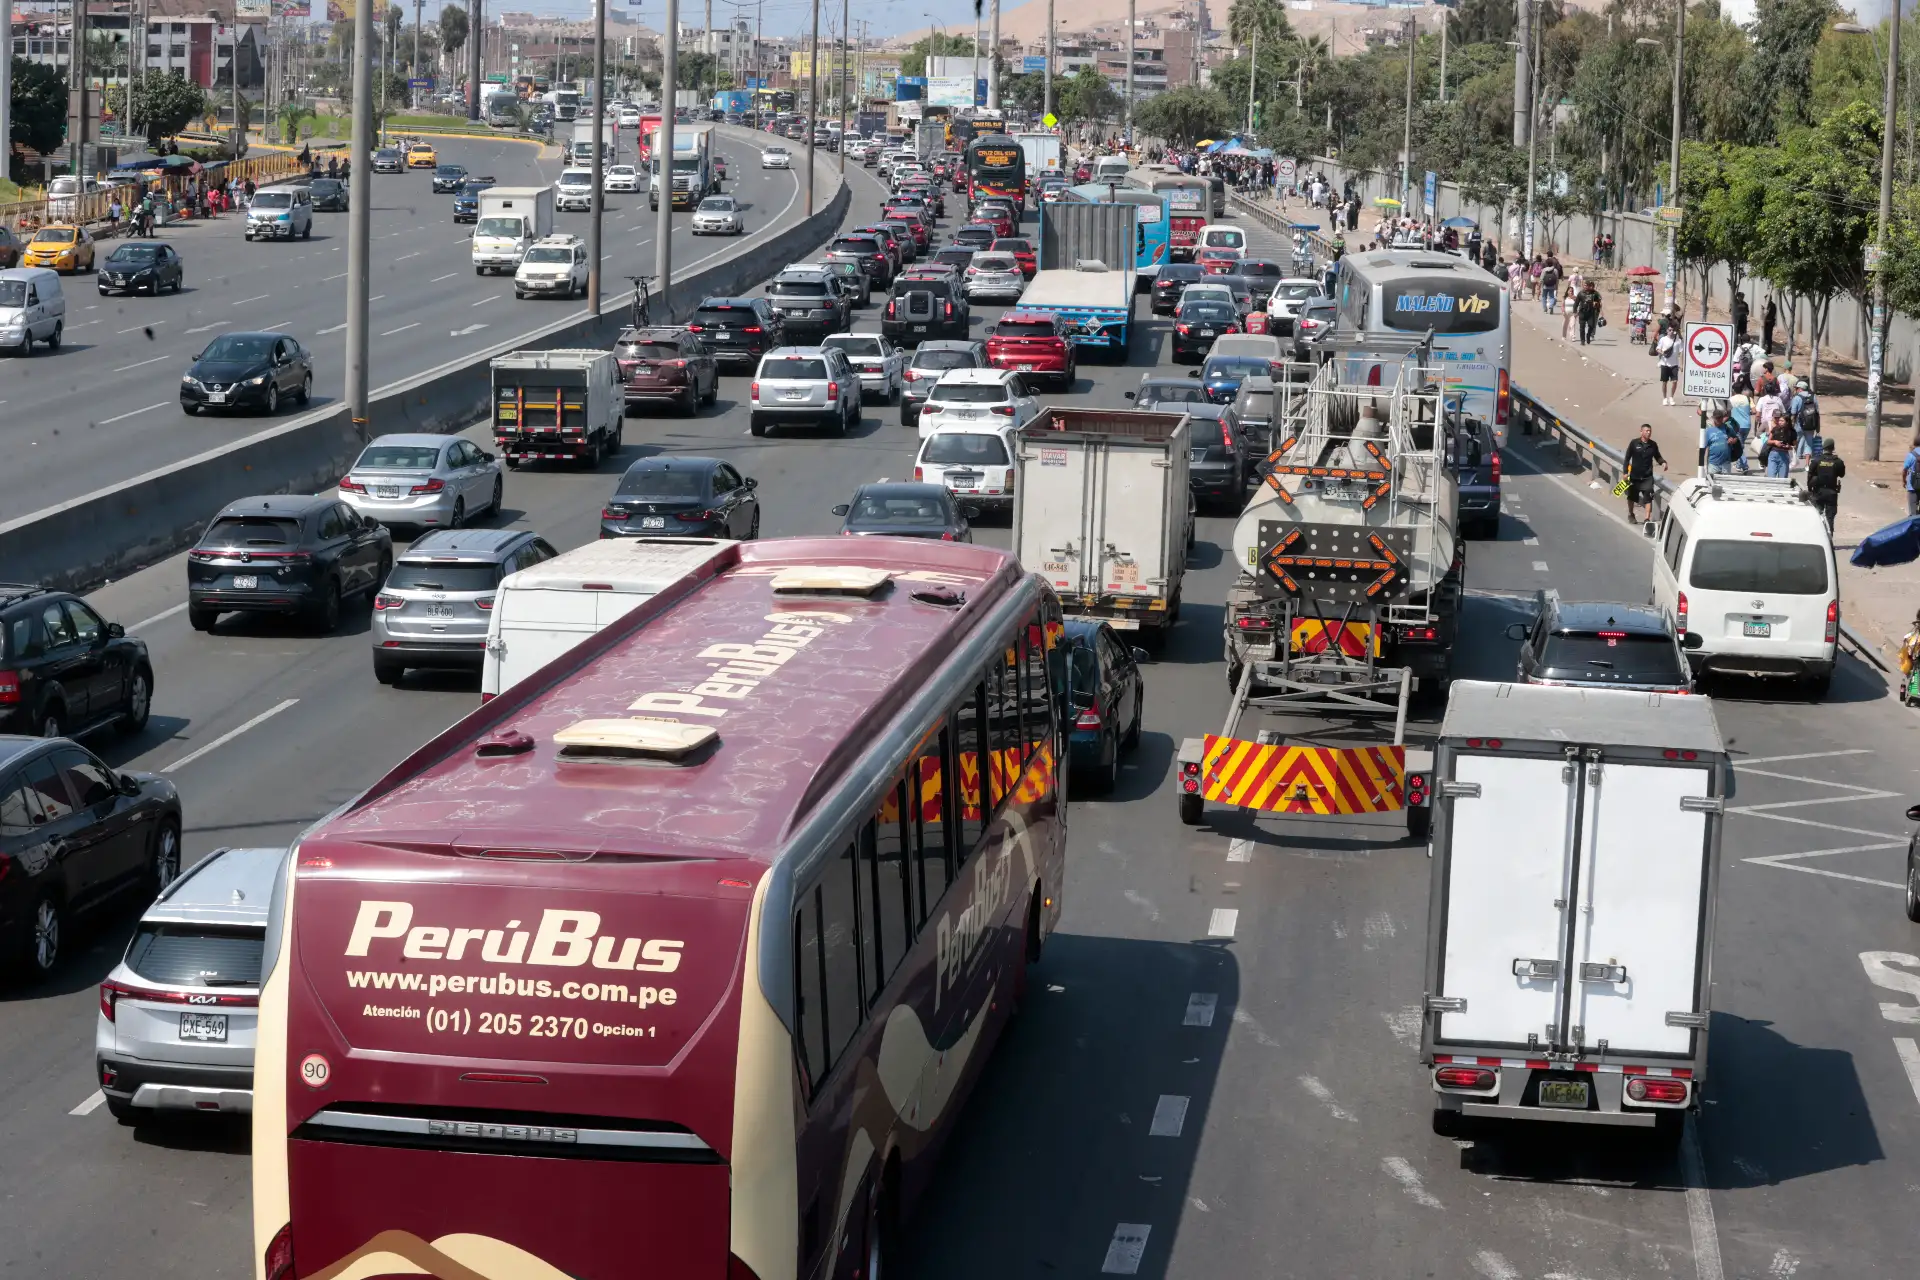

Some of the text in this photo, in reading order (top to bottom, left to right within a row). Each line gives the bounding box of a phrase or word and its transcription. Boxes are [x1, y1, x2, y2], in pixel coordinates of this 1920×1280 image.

[1458, 294, 1490, 313] VIP
[1689, 369, 1726, 379] MANTENGA
[1687, 384, 1726, 394] DERECHA
[1251, 549, 1257, 563] B
[344, 900, 685, 973] PerúBus
[346, 970, 678, 1010] www.perubus.com.pe
[183, 1019, 224, 1035] CXE-549
[362, 1004, 656, 1040] Atención (01) 205 2370 Opcion 1
[304, 1062, 327, 1079] 90
[429, 1120, 578, 1143] NEOBUS
